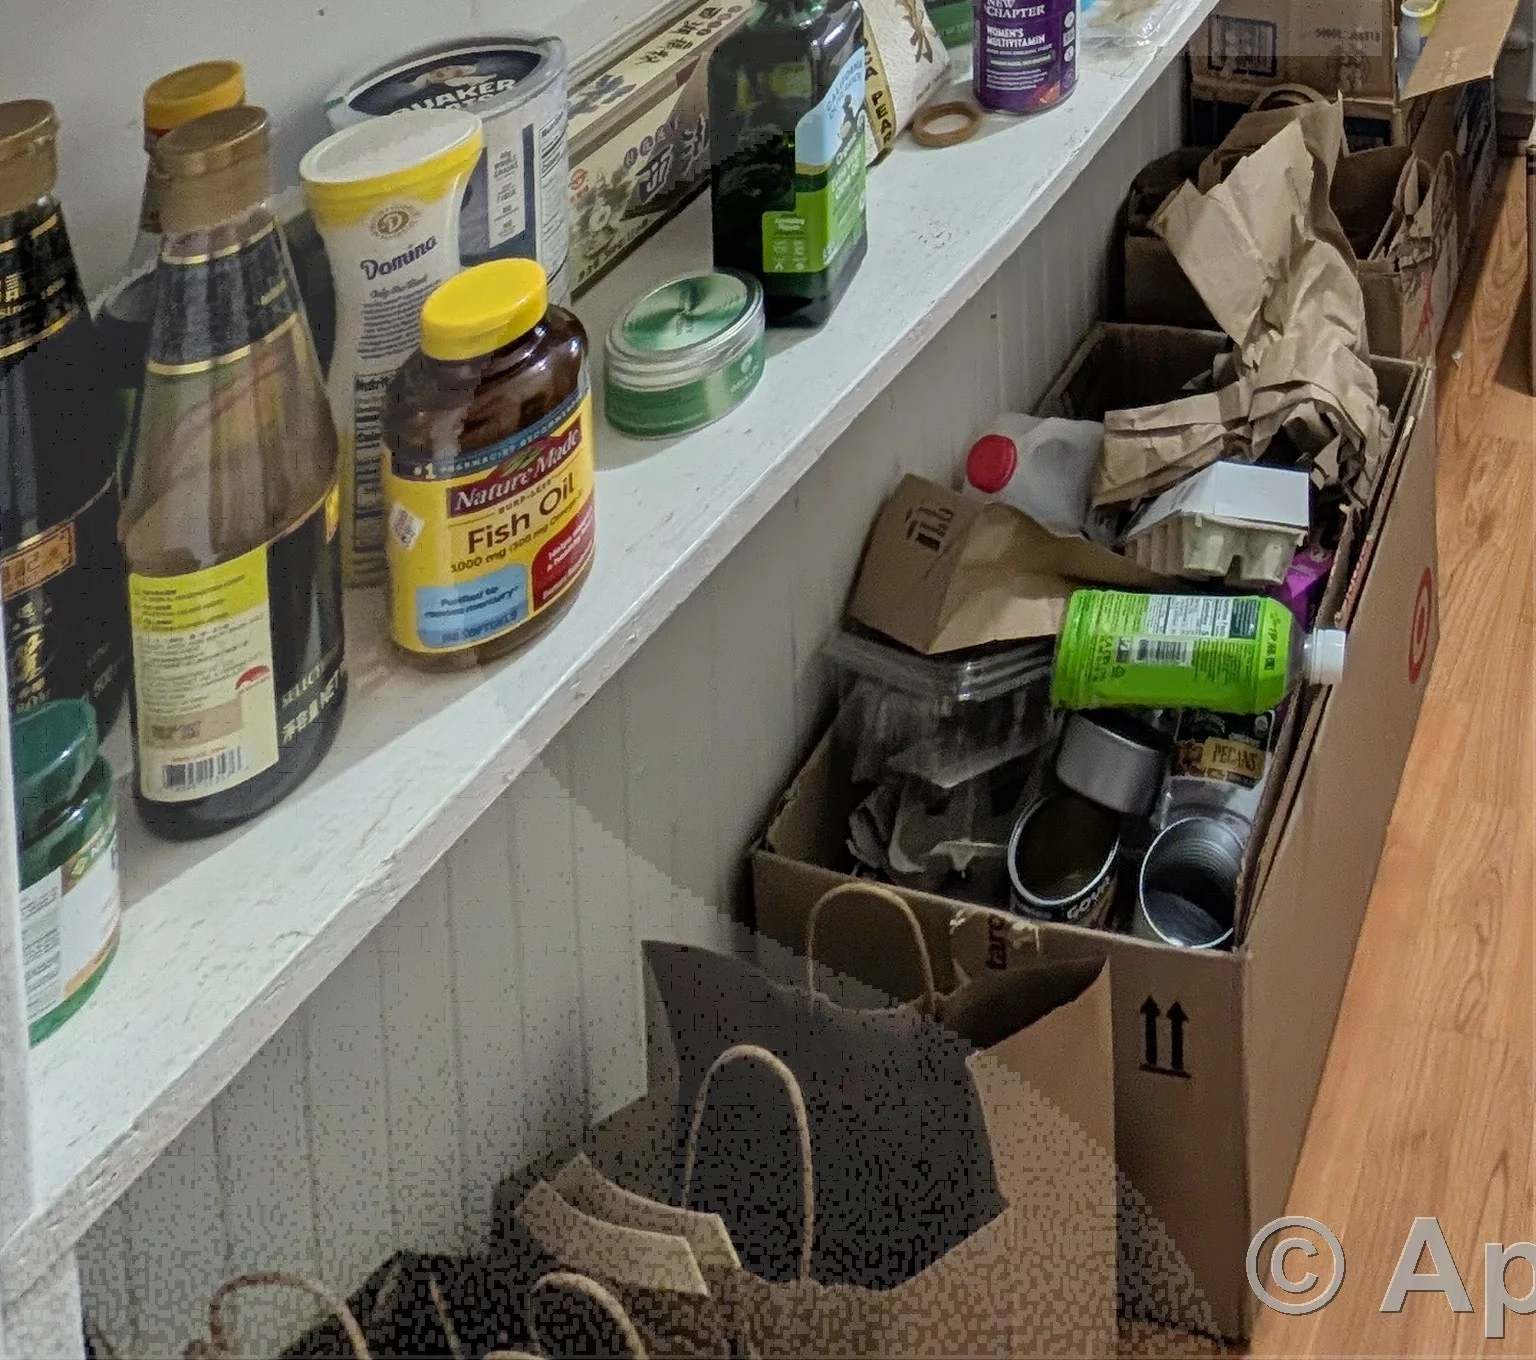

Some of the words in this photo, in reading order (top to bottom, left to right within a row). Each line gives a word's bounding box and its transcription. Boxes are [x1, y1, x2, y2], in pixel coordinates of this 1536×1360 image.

[986, 4, 1046, 19] CHAPTER
[359, 235, 437, 281] Domino
[454, 466, 534, 511] Nature
[534, 427, 580, 479] Made
[467, 510, 531, 555] Fish
[539, 472, 575, 516] Oil
[450, 554, 483, 575] 1000
[485, 547, 508, 565] mg
[1211, 743, 1257, 772] PECANS
